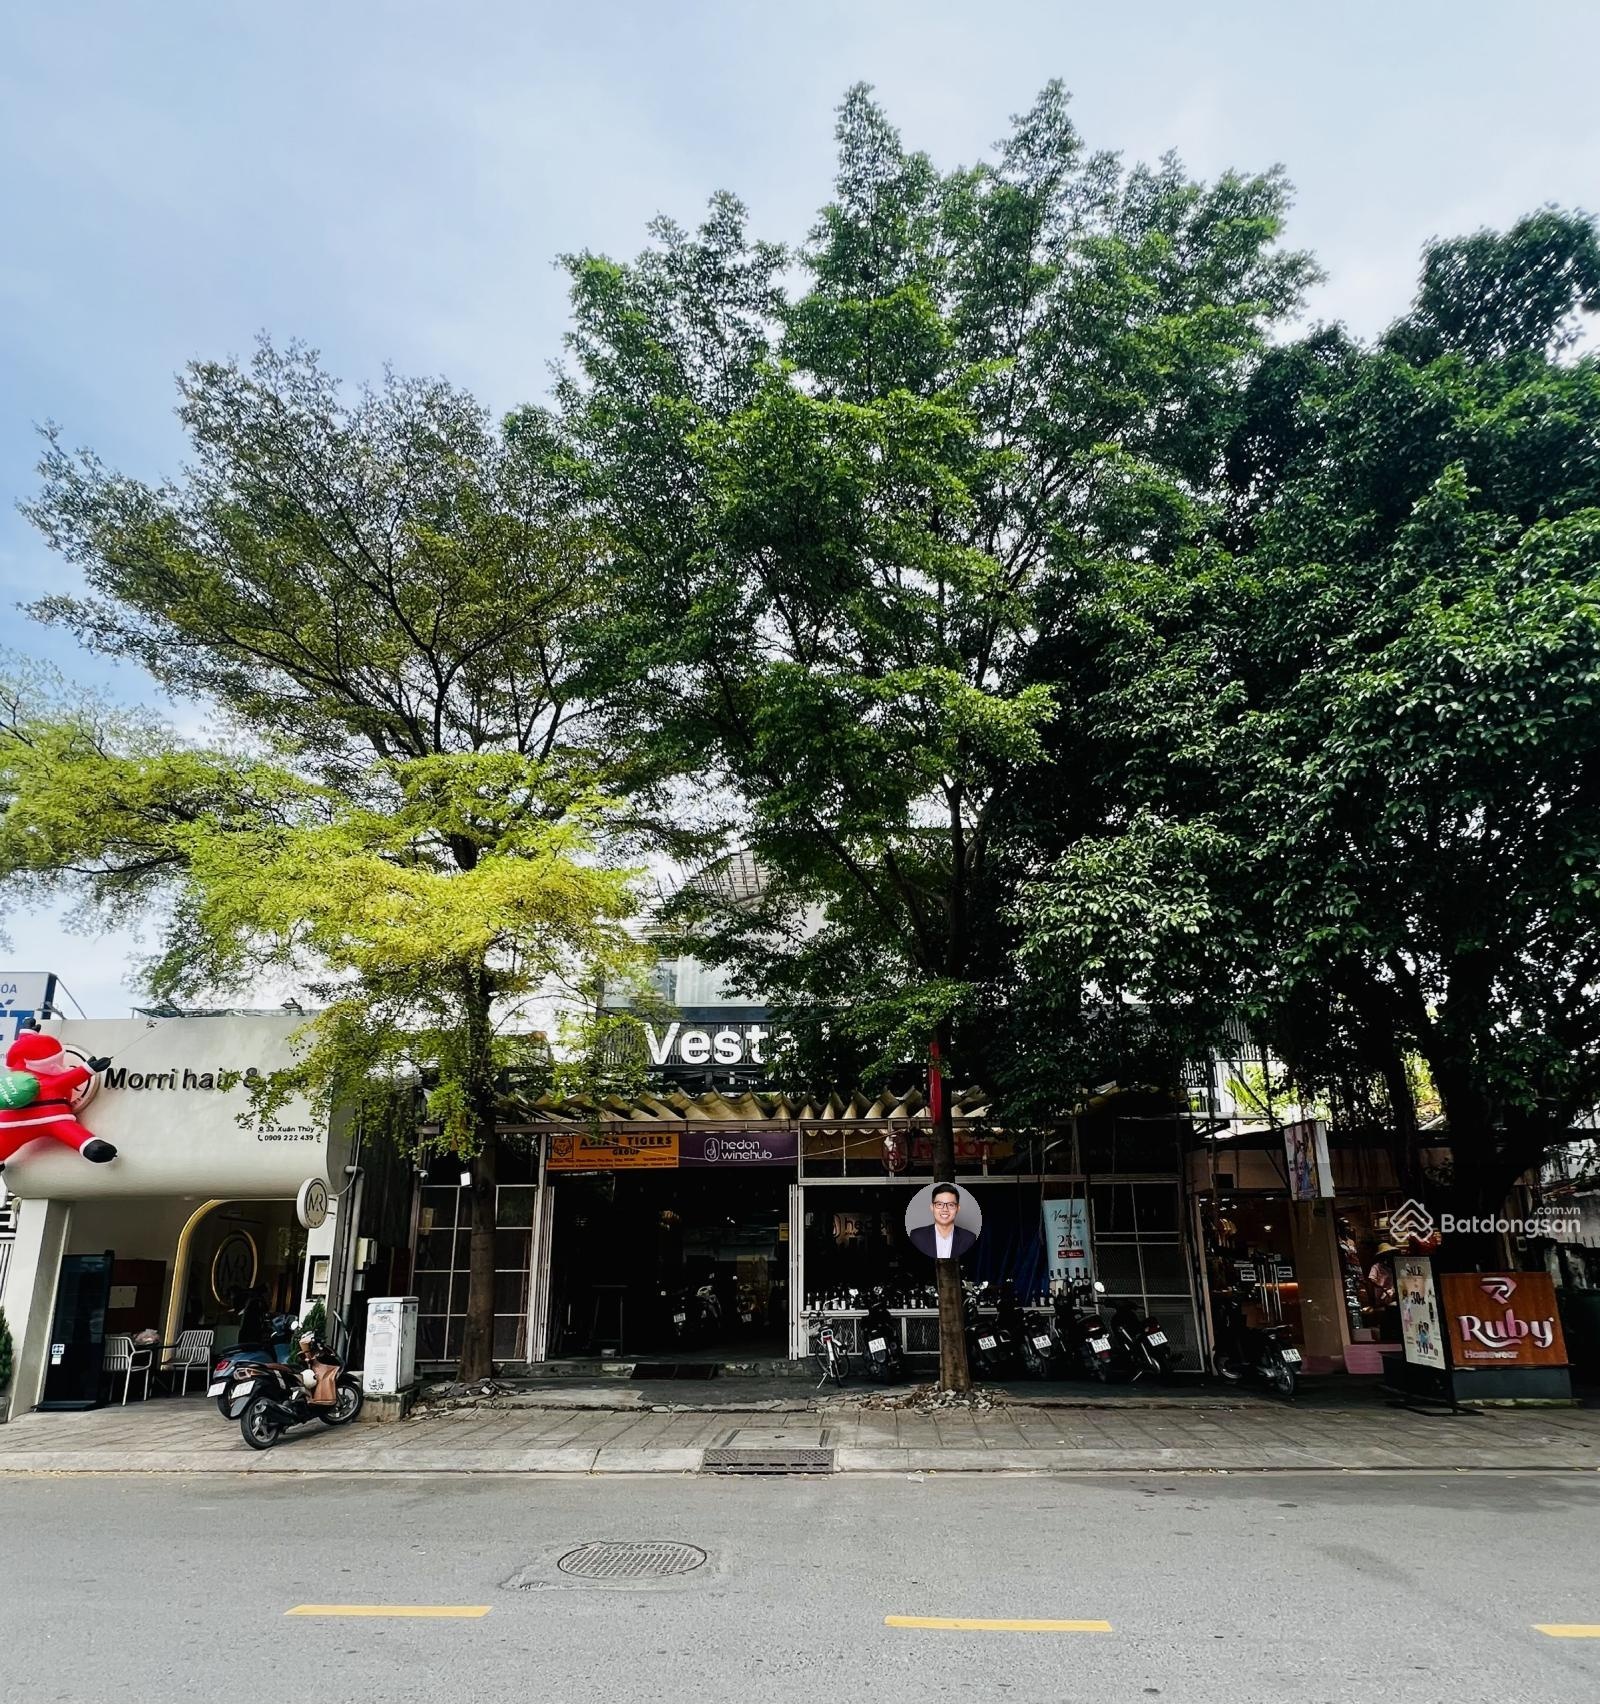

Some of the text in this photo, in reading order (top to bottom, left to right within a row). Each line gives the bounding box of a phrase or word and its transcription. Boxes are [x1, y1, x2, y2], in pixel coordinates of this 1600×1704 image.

[0, 983, 17, 994] OA
[104, 1067, 178, 1089] Morri
[626, 1136, 672, 1146] TIGERS
[721, 1139, 760, 1150] hedon
[612, 1148, 640, 1156] GROUP
[721, 1150, 773, 1160] winehub
[1406, 1265, 1425, 1277] SALE
[1456, 1309, 1555, 1348] Ruby
